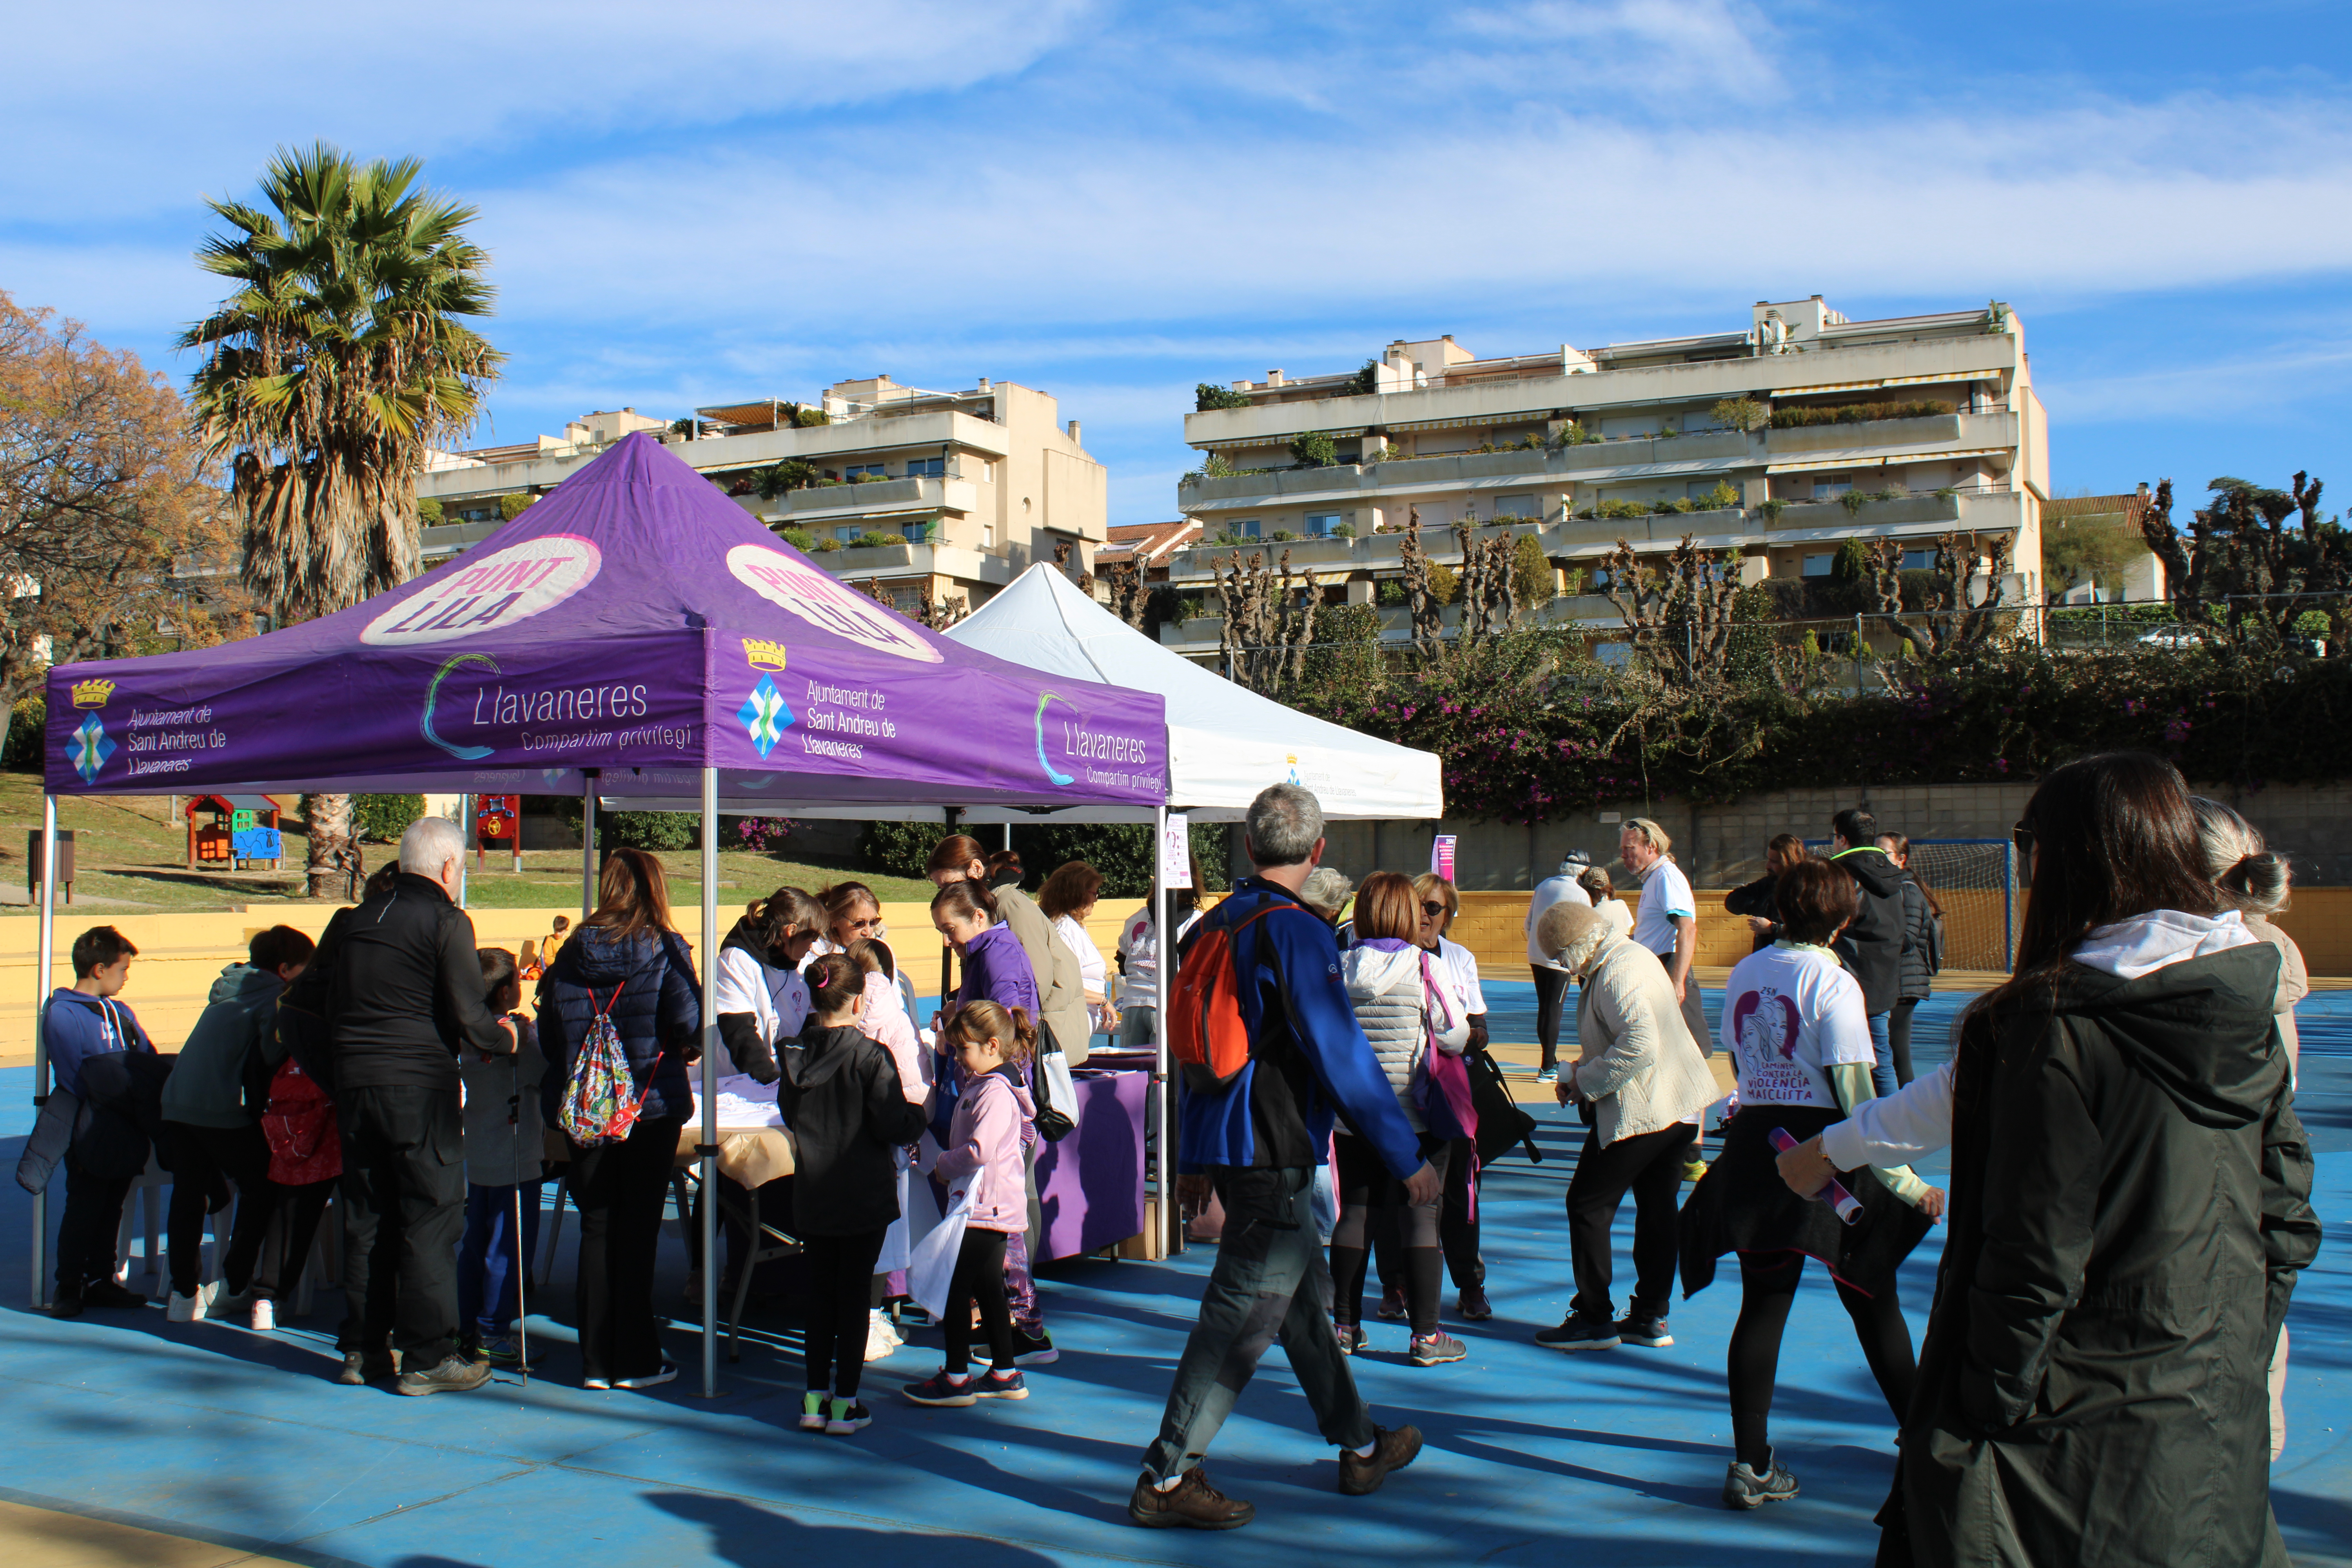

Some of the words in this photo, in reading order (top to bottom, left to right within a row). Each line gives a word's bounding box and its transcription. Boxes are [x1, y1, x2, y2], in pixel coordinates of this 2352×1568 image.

[437, 557, 575, 598] PUNT
[744, 564, 855, 609] PUNT
[382, 592, 526, 634] LILA
[789, 597, 917, 650] LILA
[474, 684, 647, 725] Llavaneres
[807, 680, 868, 708] Ajuntament
[871, 689, 885, 710] de
[127, 708, 194, 730] Ajuntament
[196, 705, 212, 724] de
[807, 708, 835, 731] Sant
[837, 711, 878, 736] Andreu
[882, 718, 896, 738] de
[128, 732, 157, 752] Sant
[159, 730, 205, 750] Andreu
[210, 729, 226, 748] de
[521, 729, 612, 752] Compartim
[619, 724, 691, 750] privilegi
[802, 733, 864, 759] Llavaneres
[1064, 721, 1146, 764] Llavaneres
[127, 758, 190, 775] Llavaneres
[1087, 766, 1129, 788] Compartim
[1132, 772, 1161, 793] privilegi
[1304, 770, 1325, 782] Ajuntament
[1325, 772, 1330, 782] de
[1314, 784, 1329, 795] Andreu
[1330, 785, 1335, 795] de
[1335, 785, 1356, 797] Llavaneres
[1760, 986, 1778, 996] 25N
[1757, 1070, 1791, 1078] CONTRA
